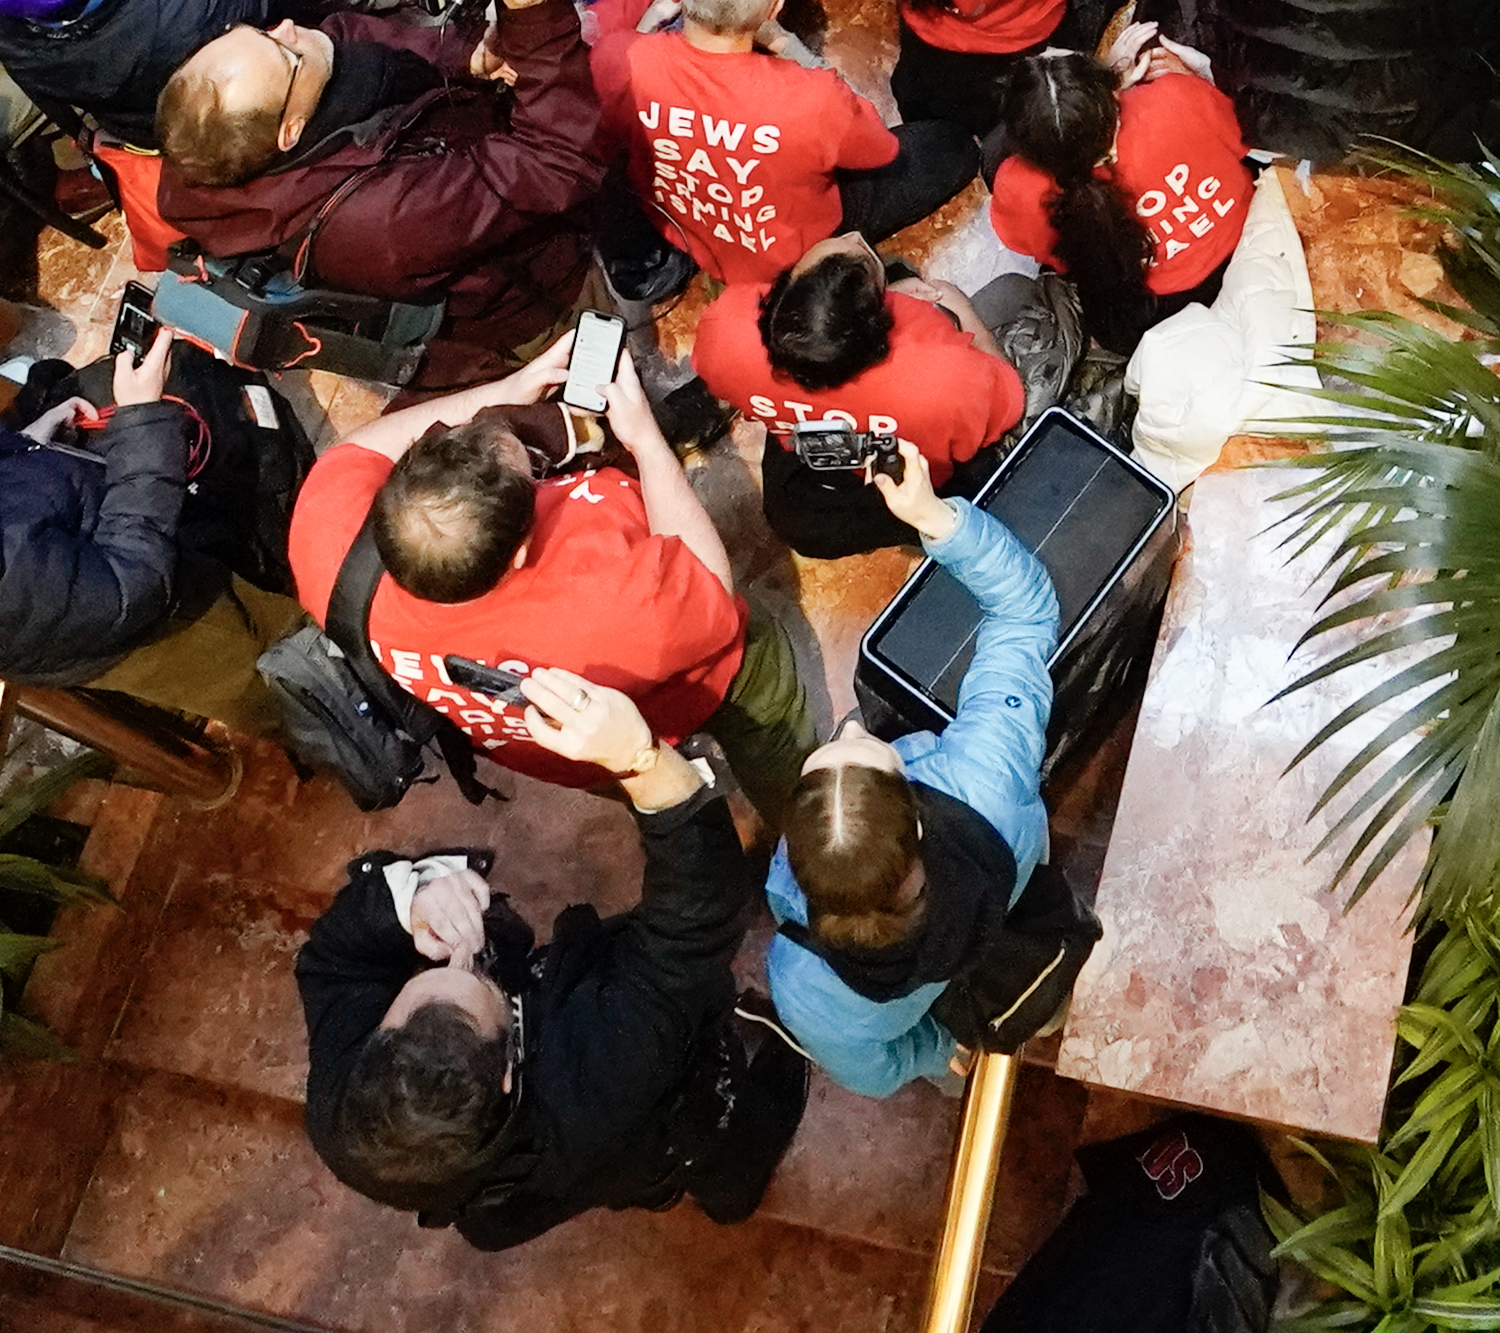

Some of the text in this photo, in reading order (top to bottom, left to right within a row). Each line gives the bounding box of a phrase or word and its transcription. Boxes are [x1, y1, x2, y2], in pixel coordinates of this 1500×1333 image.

[639, 102, 782, 154] JEWS
[653, 138, 762, 187] SAY
[653, 160, 765, 210] STOP
[749, 394, 898, 439] STOP
